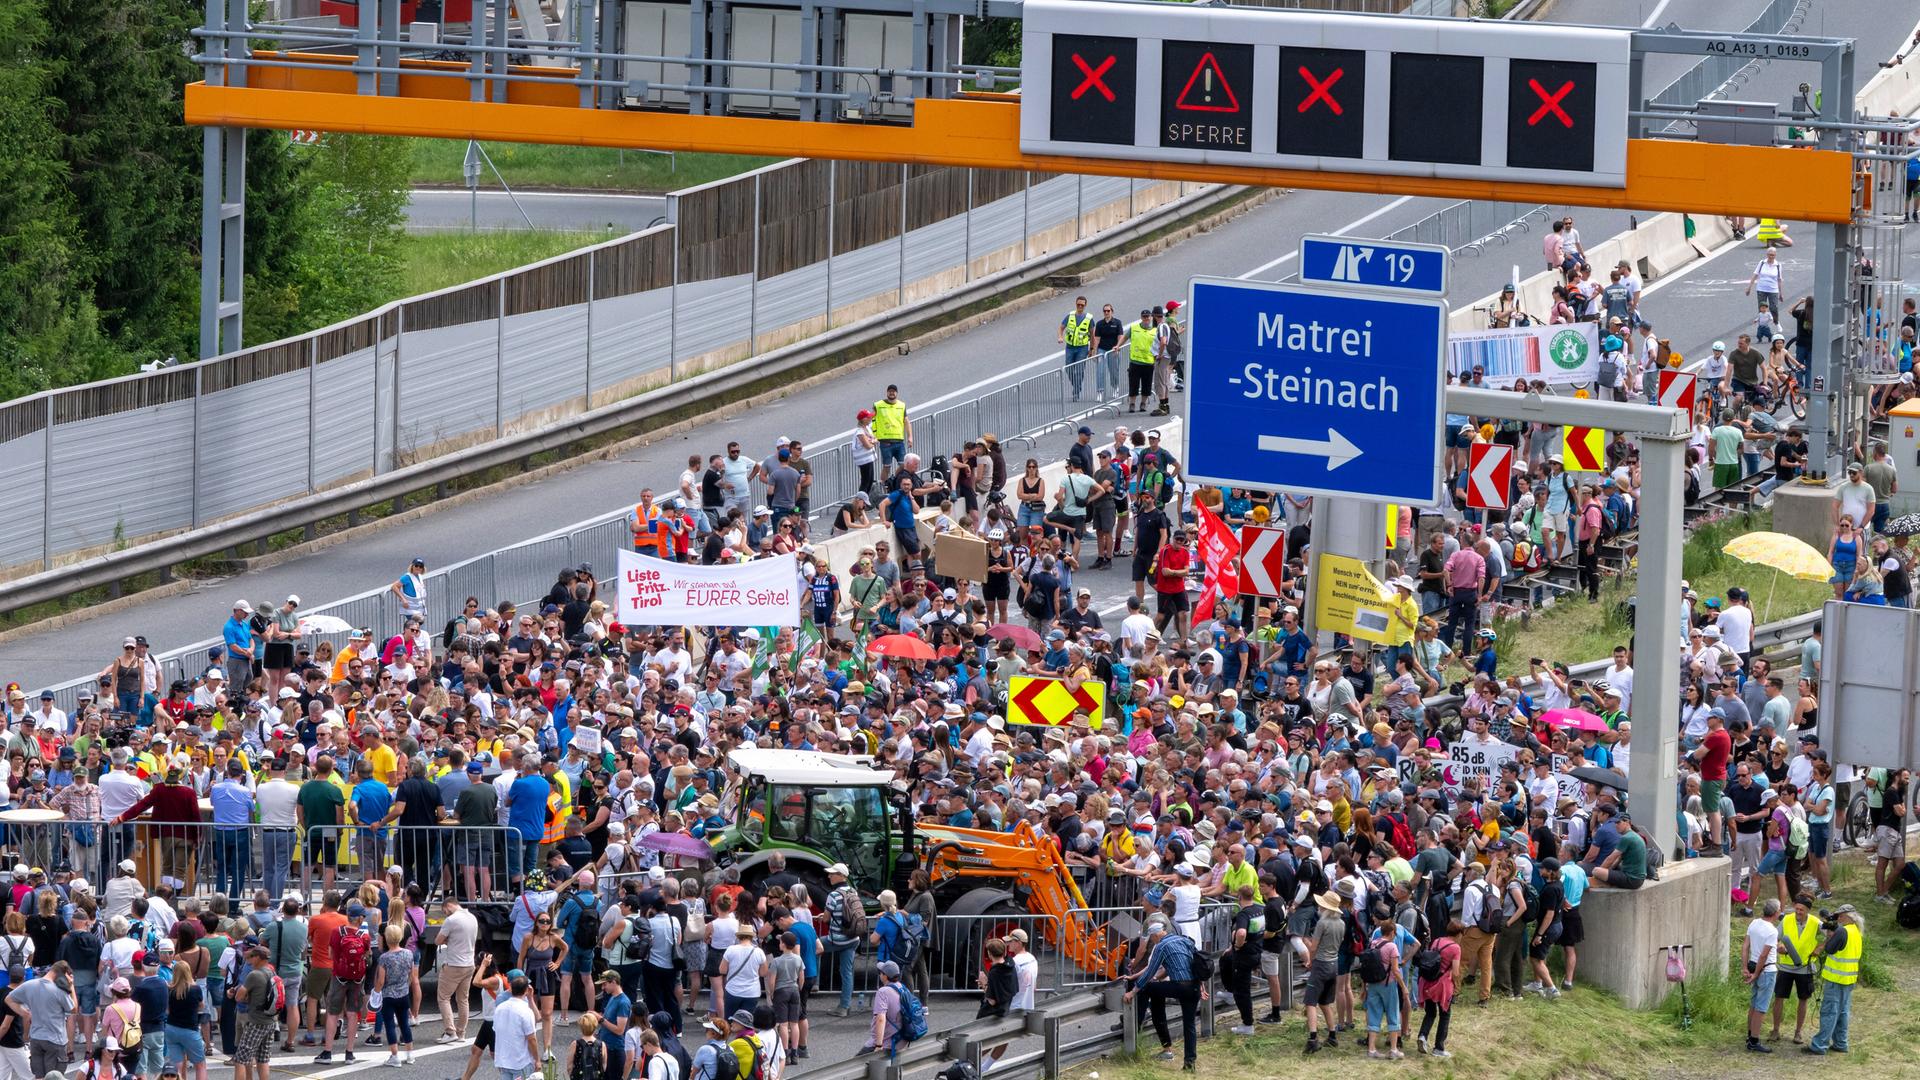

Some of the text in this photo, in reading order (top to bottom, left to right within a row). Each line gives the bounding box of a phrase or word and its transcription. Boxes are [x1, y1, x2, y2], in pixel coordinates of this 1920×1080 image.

[1168, 123, 1246, 145] SPERRE
[1384, 253, 1415, 283] 19
[1257, 312, 1372, 358] Matrei
[1228, 363, 1399, 413] -Steinach
[627, 569, 660, 583] Liste
[673, 579, 688, 590] Wir
[637, 581, 671, 595] Fritz.
[631, 594, 662, 610] Tirol
[685, 589, 790, 607] EURER Seite!
[1452, 746, 1485, 764] 85 dB
